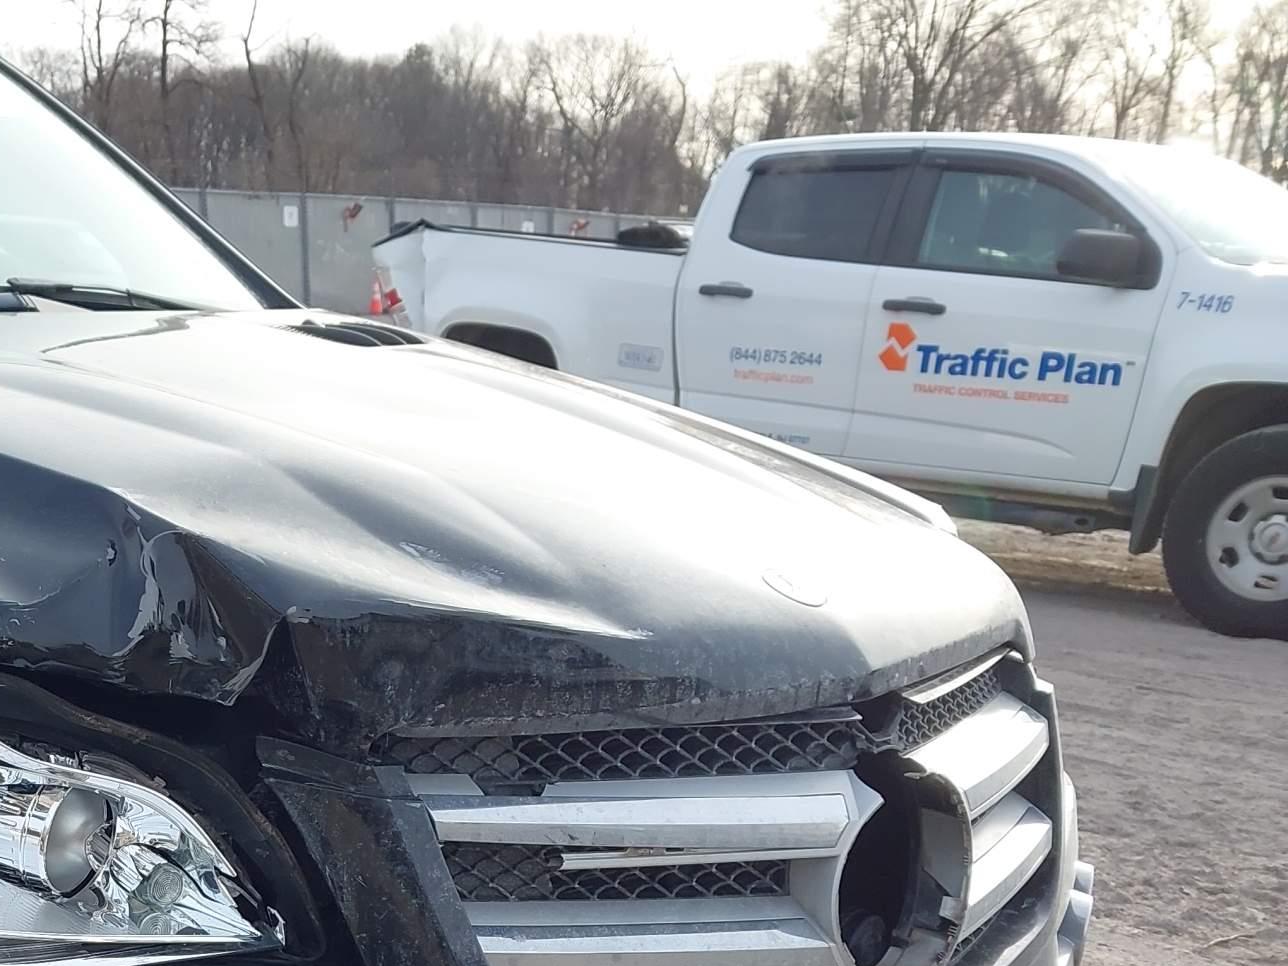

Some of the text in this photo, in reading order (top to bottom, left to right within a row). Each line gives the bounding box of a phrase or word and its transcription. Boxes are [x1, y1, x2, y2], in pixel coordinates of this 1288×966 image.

[1177, 291, 1234, 314] 7-1416
[730, 346, 822, 366] (844) 875 2644
[916, 344, 1123, 387] Traffic Plan
[912, 382, 1069, 404] TRAFFIC CONTROL SERVICES
